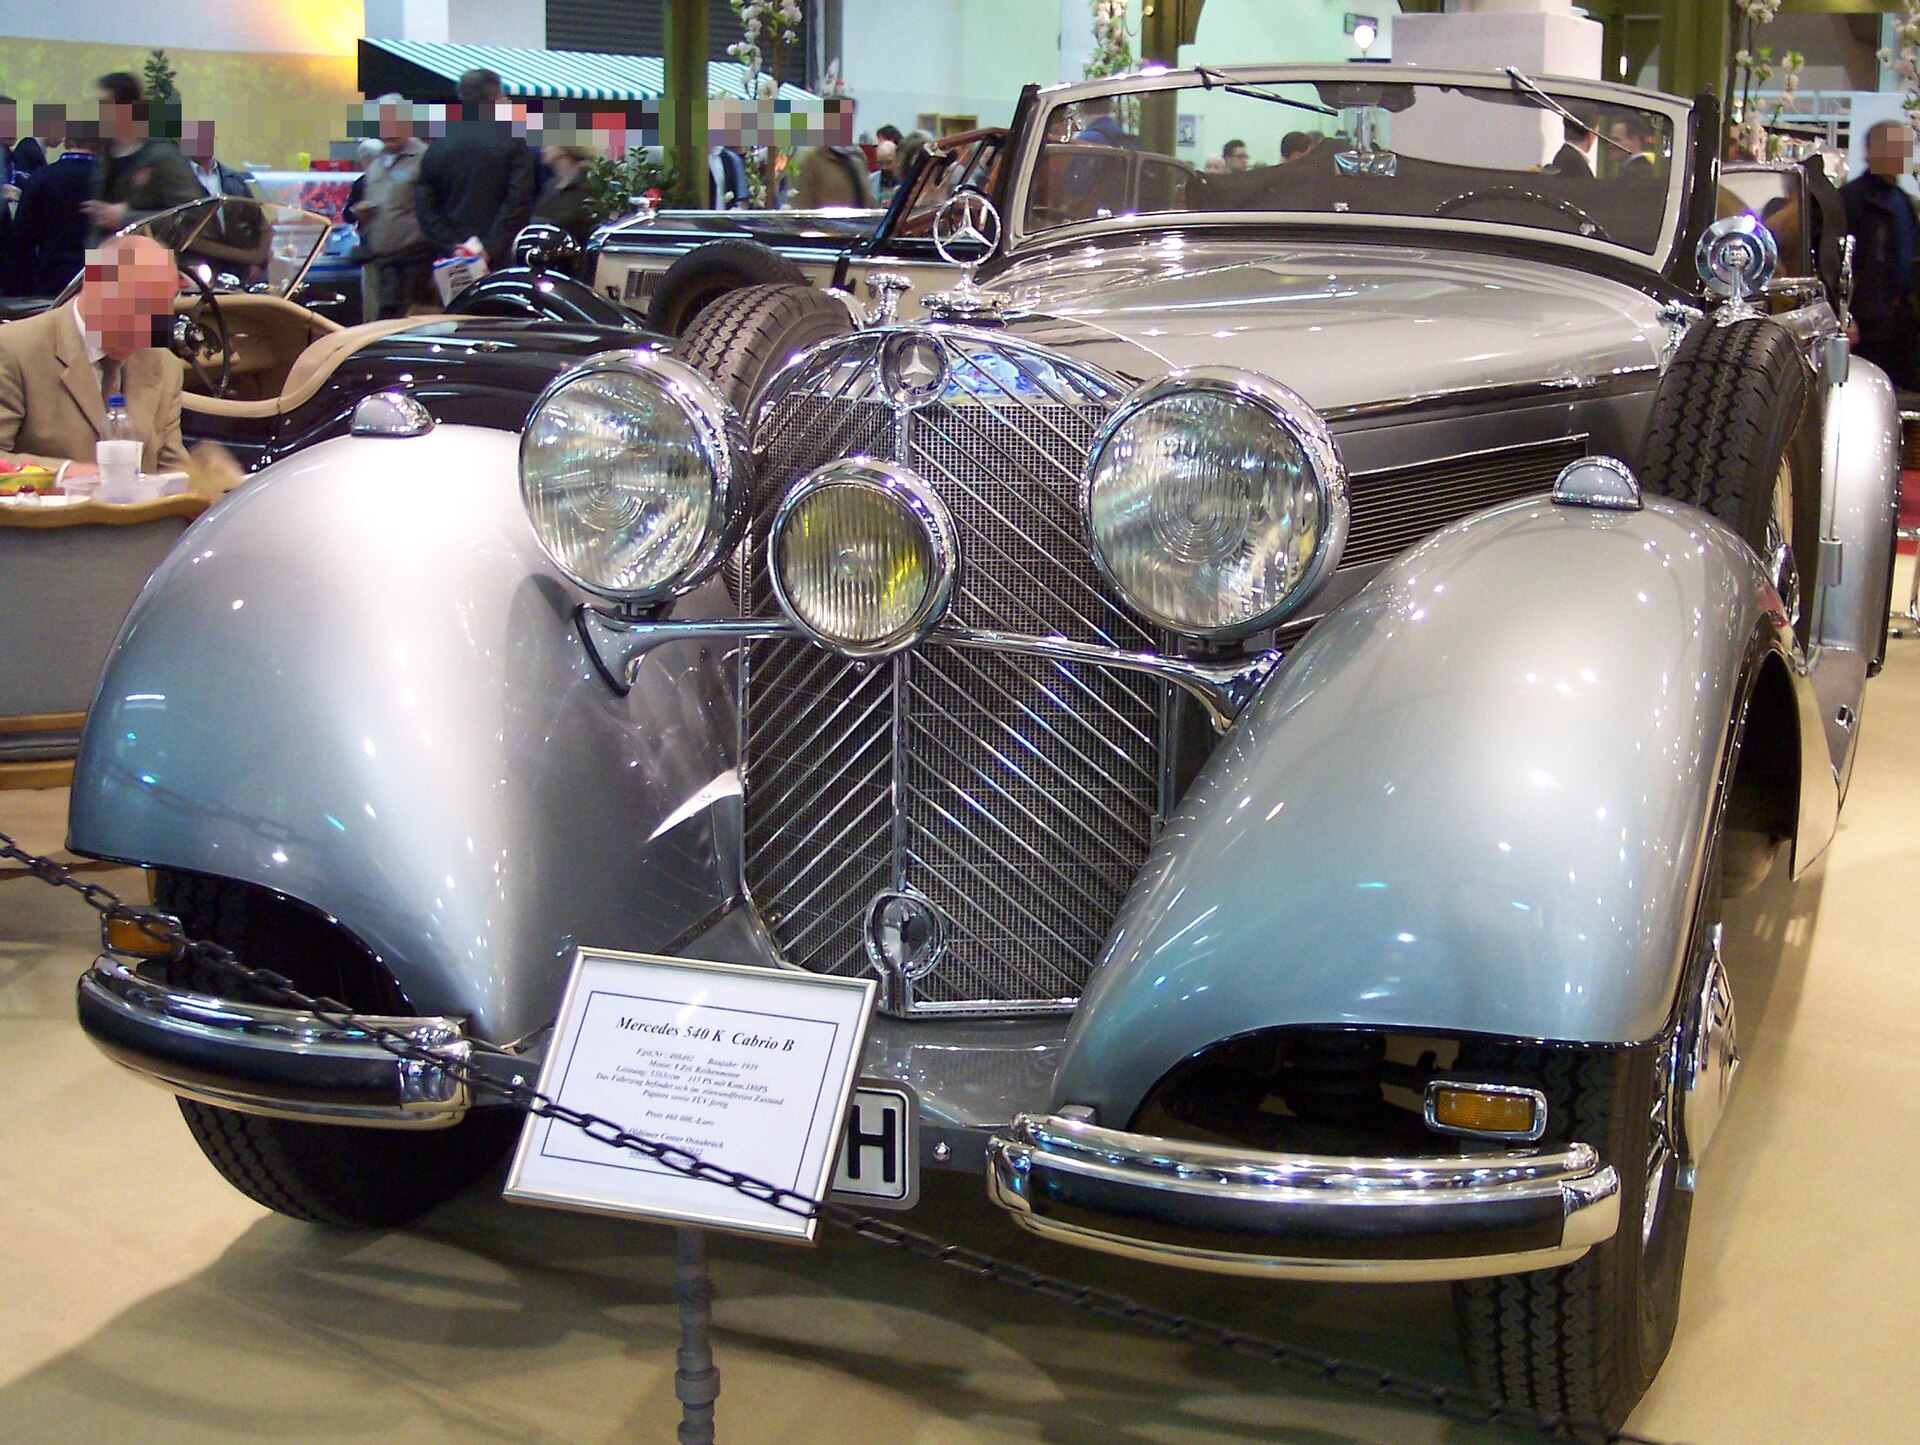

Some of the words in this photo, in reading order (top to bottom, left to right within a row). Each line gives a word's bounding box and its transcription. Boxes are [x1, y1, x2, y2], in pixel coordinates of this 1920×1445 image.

[616, 1016, 680, 1037] Mercedes
[684, 1025, 710, 1040] 540
[712, 1029, 725, 1043] K
[732, 1032, 778, 1050] Cabrio
[782, 1039, 795, 1052] B
[596, 1072, 609, 1080] Das
[611, 1073, 644, 1086] Fahrzeug
[644, 1079, 674, 1090] befindet
[674, 1084, 689, 1092] sich
[702, 1088, 753, 1101] einwandfreien
[752, 1094, 785, 1106] Zustand
[701, 1077, 712, 1085] PS
[642, 1089, 669, 1099] Papiere
[670, 1094, 691, 1102] sowie
[708, 1099, 729, 1109] fertig
[645, 1110, 663, 1119] Preis
[685, 1136, 724, 1148] Osnabrück
[847, 1103, 896, 1183] H
